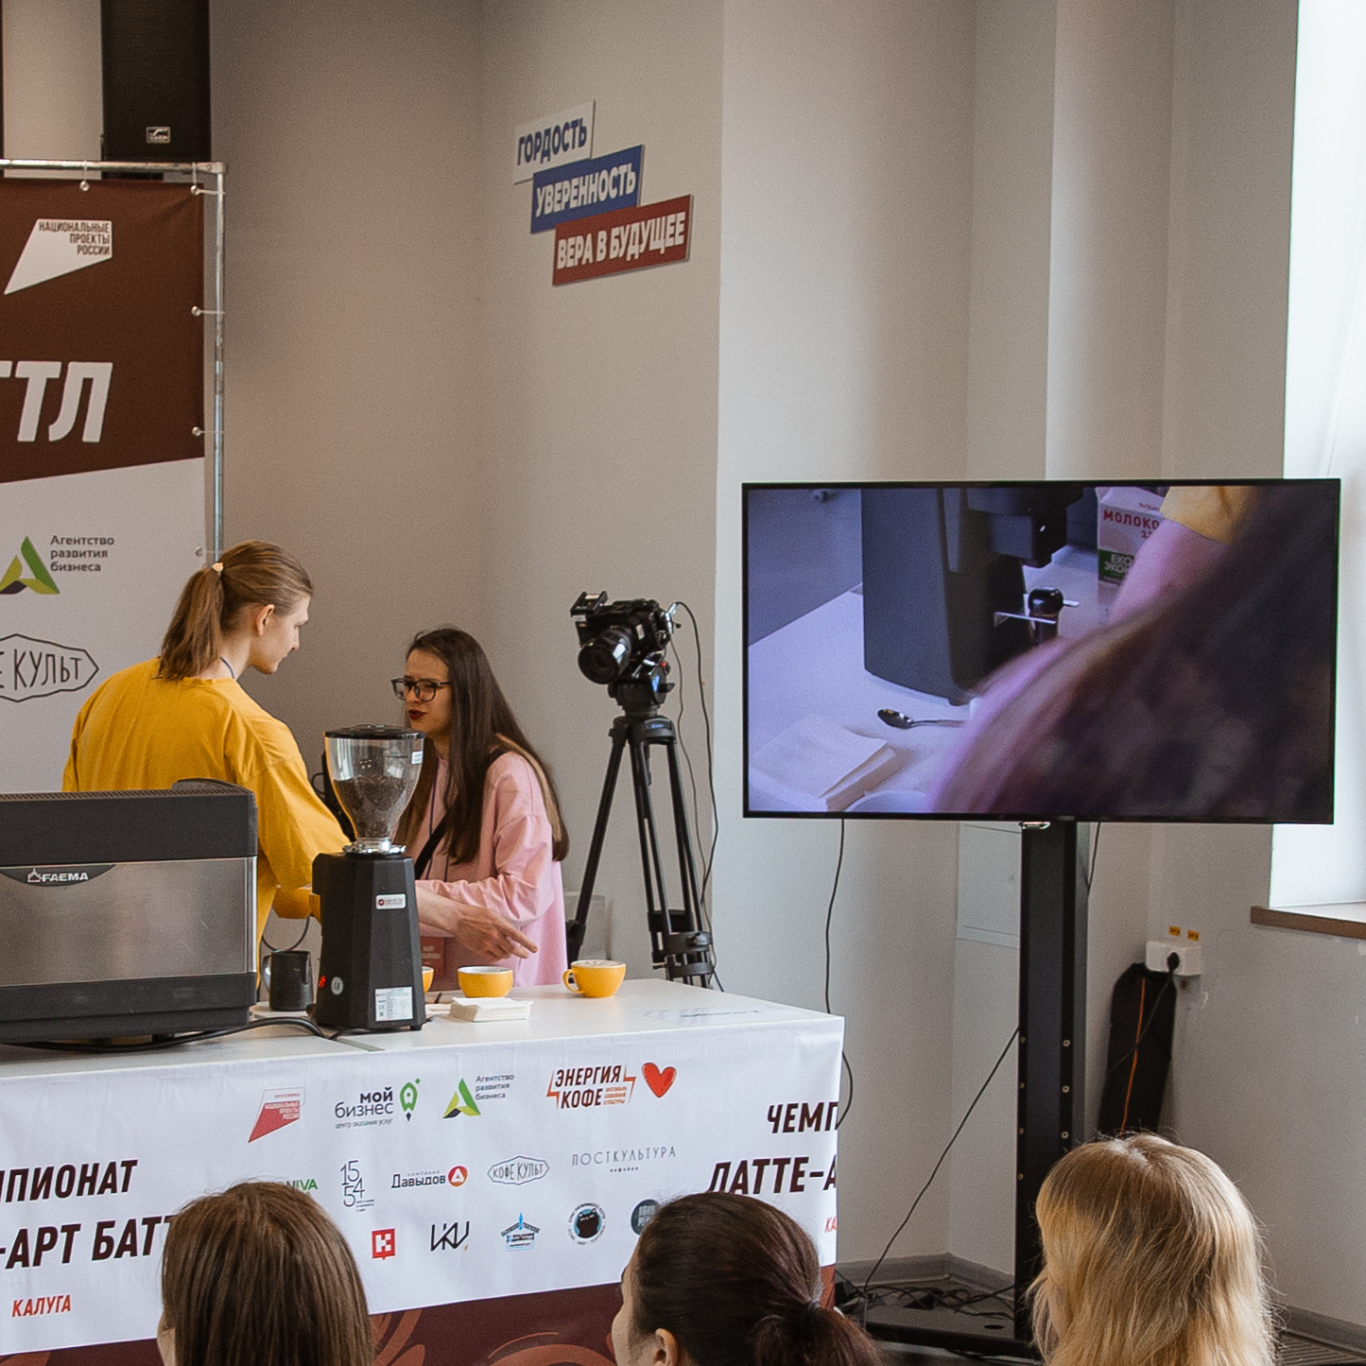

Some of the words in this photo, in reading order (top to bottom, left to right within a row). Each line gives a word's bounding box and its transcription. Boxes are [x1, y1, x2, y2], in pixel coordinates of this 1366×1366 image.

[516, 117, 588, 166] ГОРДОСТЬ
[535, 162, 636, 217] УВЕРЕННОСТЬ
[38, 222, 110, 233] НАЦИОНАЛЬНЫЕ
[69, 233, 110, 244] ПРОЕКТЫ
[556, 233, 593, 270] ВЕРА
[596, 230, 607, 263] В
[609, 211, 686, 261] БУДУЩЕЕ
[77, 245, 110, 255] РОССИИ
[1103, 509, 1160, 530] МОЛОКО
[50, 534, 114, 546] Агентство
[50, 549, 108, 560] развития
[50, 560, 102, 572] бизнеса
[14, 648, 82, 690] КУЛЬТ
[41, 872, 89, 883] FAEMA
[555, 1065, 622, 1087] ЭНЕРГИЯ
[360, 1087, 393, 1103] мой
[561, 1088, 603, 1109] КОФЕ
[335, 1101, 394, 1119] бизнес
[572, 1146, 677, 1167] ПОСТКУЛЬТУРА
[492, 1162, 514, 1180] КОФЕ
[517, 1161, 544, 1180] КУЛЬТ
[391, 1173, 446, 1189] Давыдов
[11, 1294, 72, 1318] КАЛУГА
